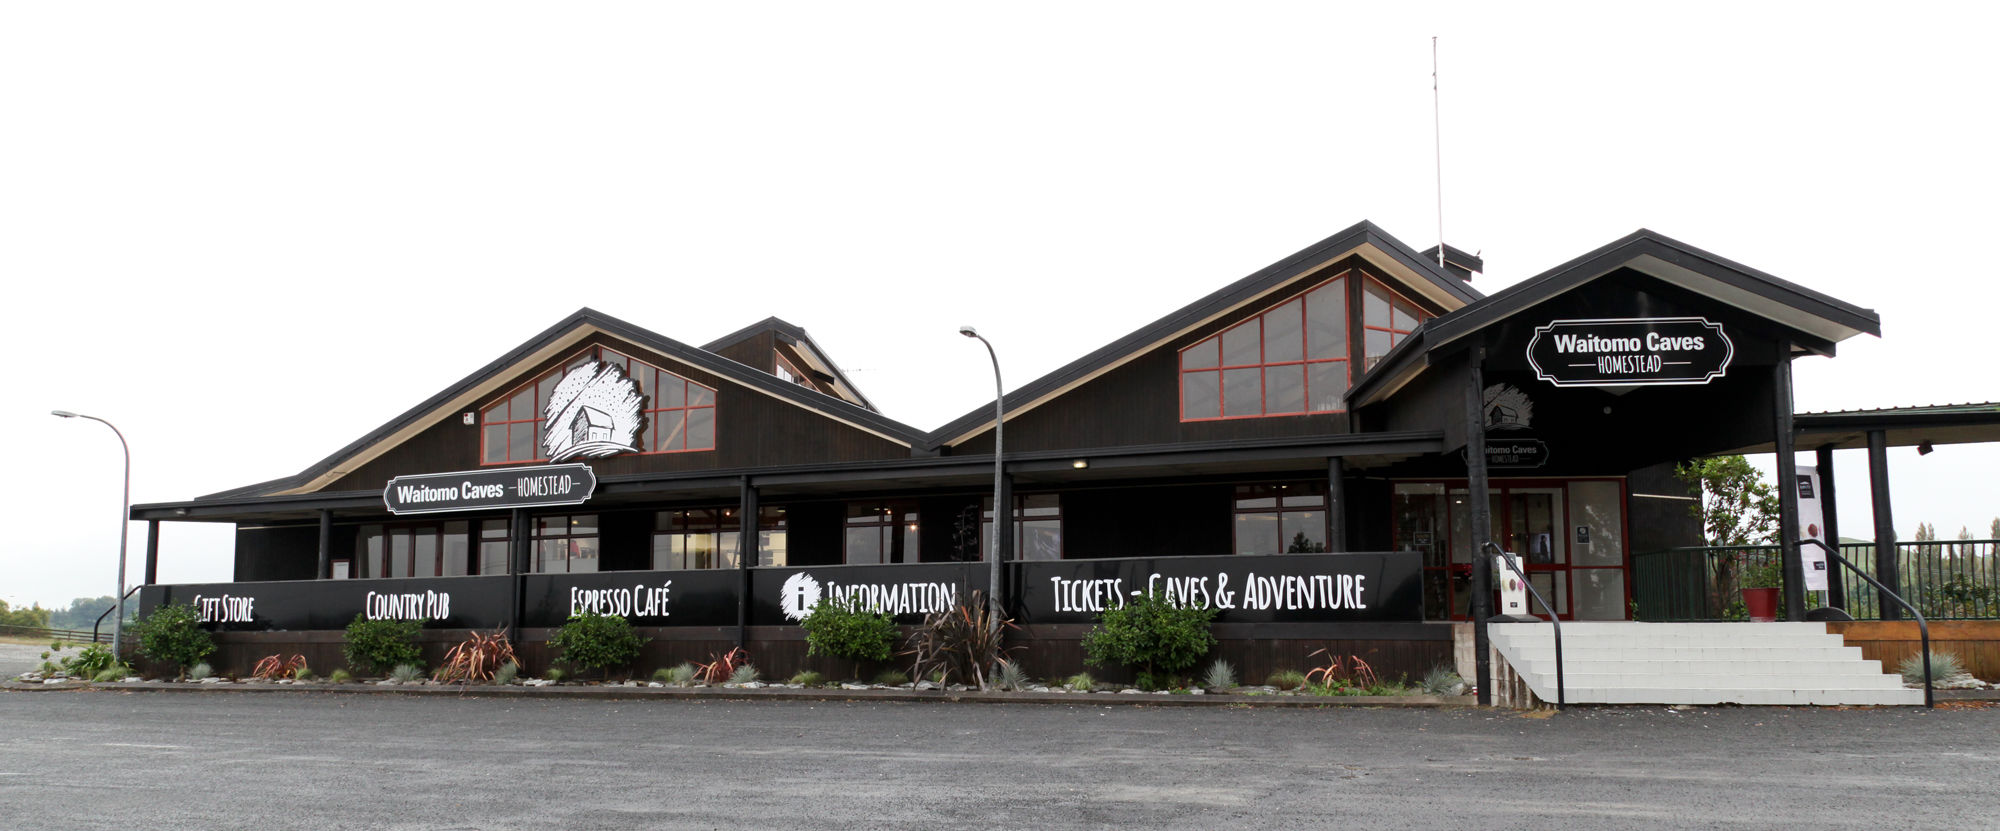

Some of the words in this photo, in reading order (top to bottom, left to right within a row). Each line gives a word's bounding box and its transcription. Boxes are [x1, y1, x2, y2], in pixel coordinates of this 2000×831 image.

[1553, 333, 1641, 353] Waitomo
[1646, 332, 1705, 352] Caves
[1597, 354, 1662, 374] HOMESTEAD
[1512, 444, 1537, 454] Caves
[397, 484, 458, 504] Waitomo
[461, 481, 504, 500] Caves
[517, 474, 572, 498] HOMESTEAD
[366, 590, 425, 620] COUNTRY
[426, 589, 450, 620] PUB
[570, 586, 631, 618] ESPRESSO
[634, 579, 672, 617] CAFÉ
[827, 581, 956, 616] INFORMATION
[1050, 576, 1124, 612] TICKETS
[1214, 572, 1236, 609] &
[1242, 572, 1367, 610] ADVENTURE
[221, 594, 255, 622] STORE
